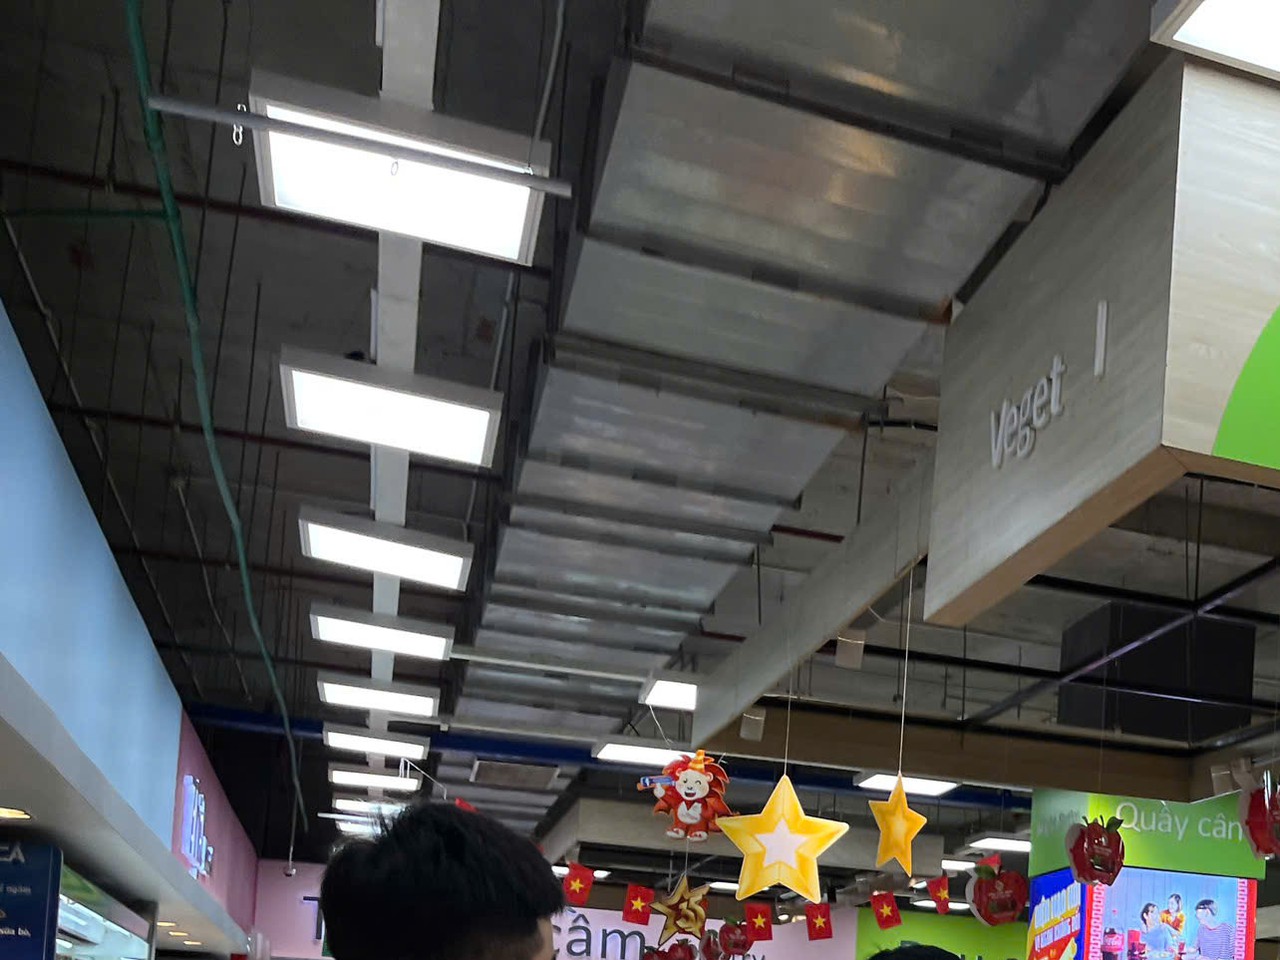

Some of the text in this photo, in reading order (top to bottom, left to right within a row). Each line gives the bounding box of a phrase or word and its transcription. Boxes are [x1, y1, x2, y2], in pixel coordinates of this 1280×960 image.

[990, 354, 1067, 468] Veget
[1115, 800, 1190, 842] Quầy
[1197, 812, 1243, 842] cân
